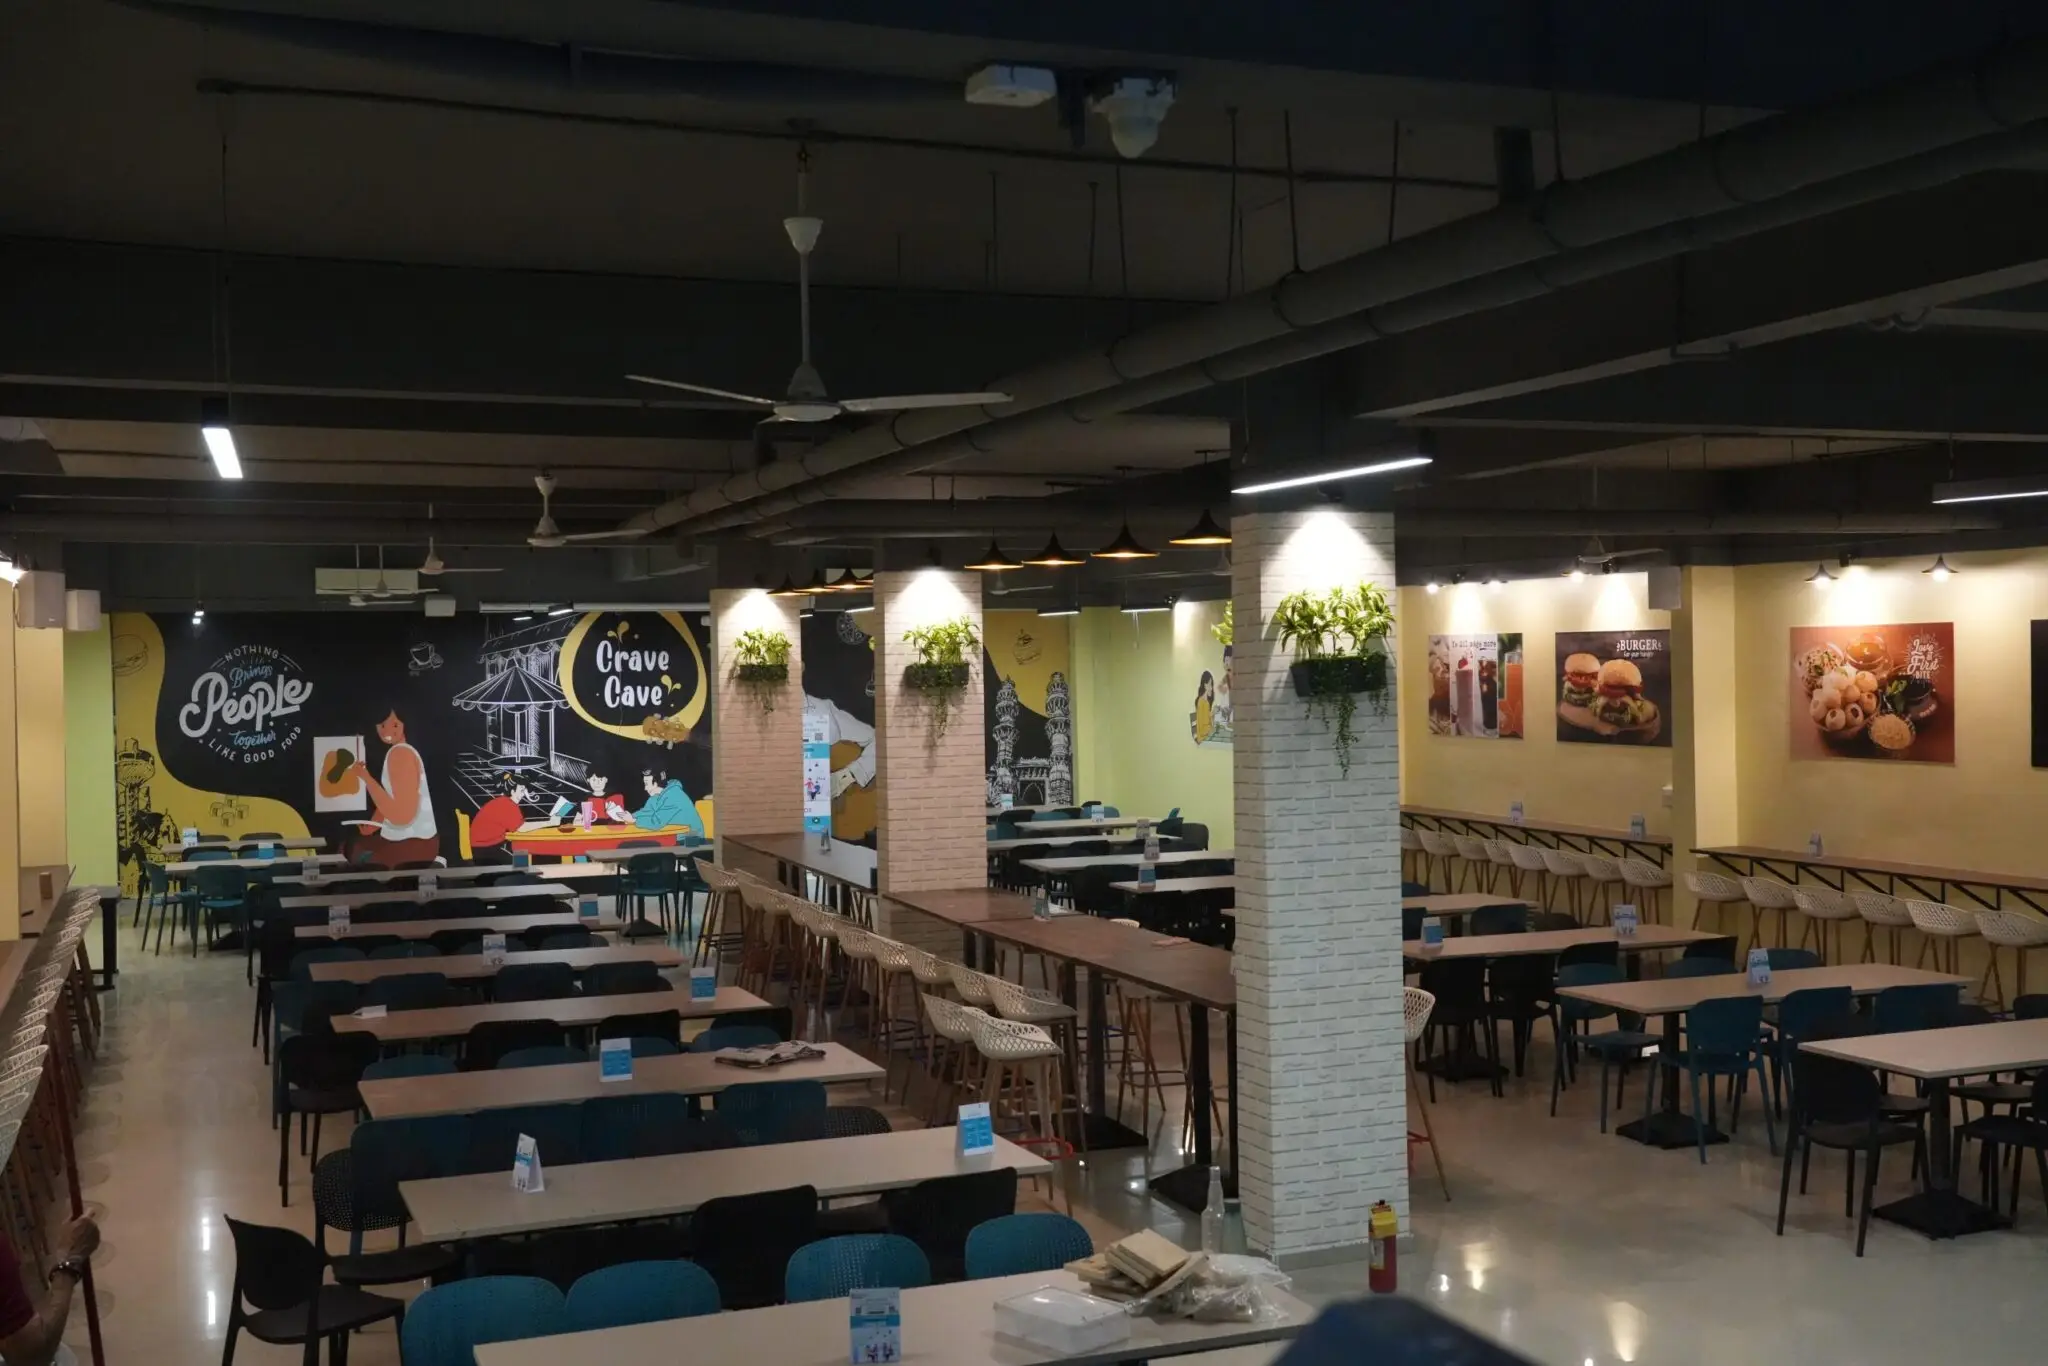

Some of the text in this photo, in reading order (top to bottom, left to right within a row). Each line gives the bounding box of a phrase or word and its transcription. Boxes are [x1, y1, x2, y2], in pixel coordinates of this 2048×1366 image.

[225, 645, 279, 661] NOTHING
[1620, 639, 1658, 650] BURGER
[1911, 639, 1934, 655] Love
[596, 640, 670, 673] Crave
[1907, 655, 1939, 675] First
[229, 665, 273, 689] Brings
[1915, 670, 1931, 680] BITE
[604, 675, 662, 708] Cave
[208, 727, 301, 763] LIKE GOOD FOOD
